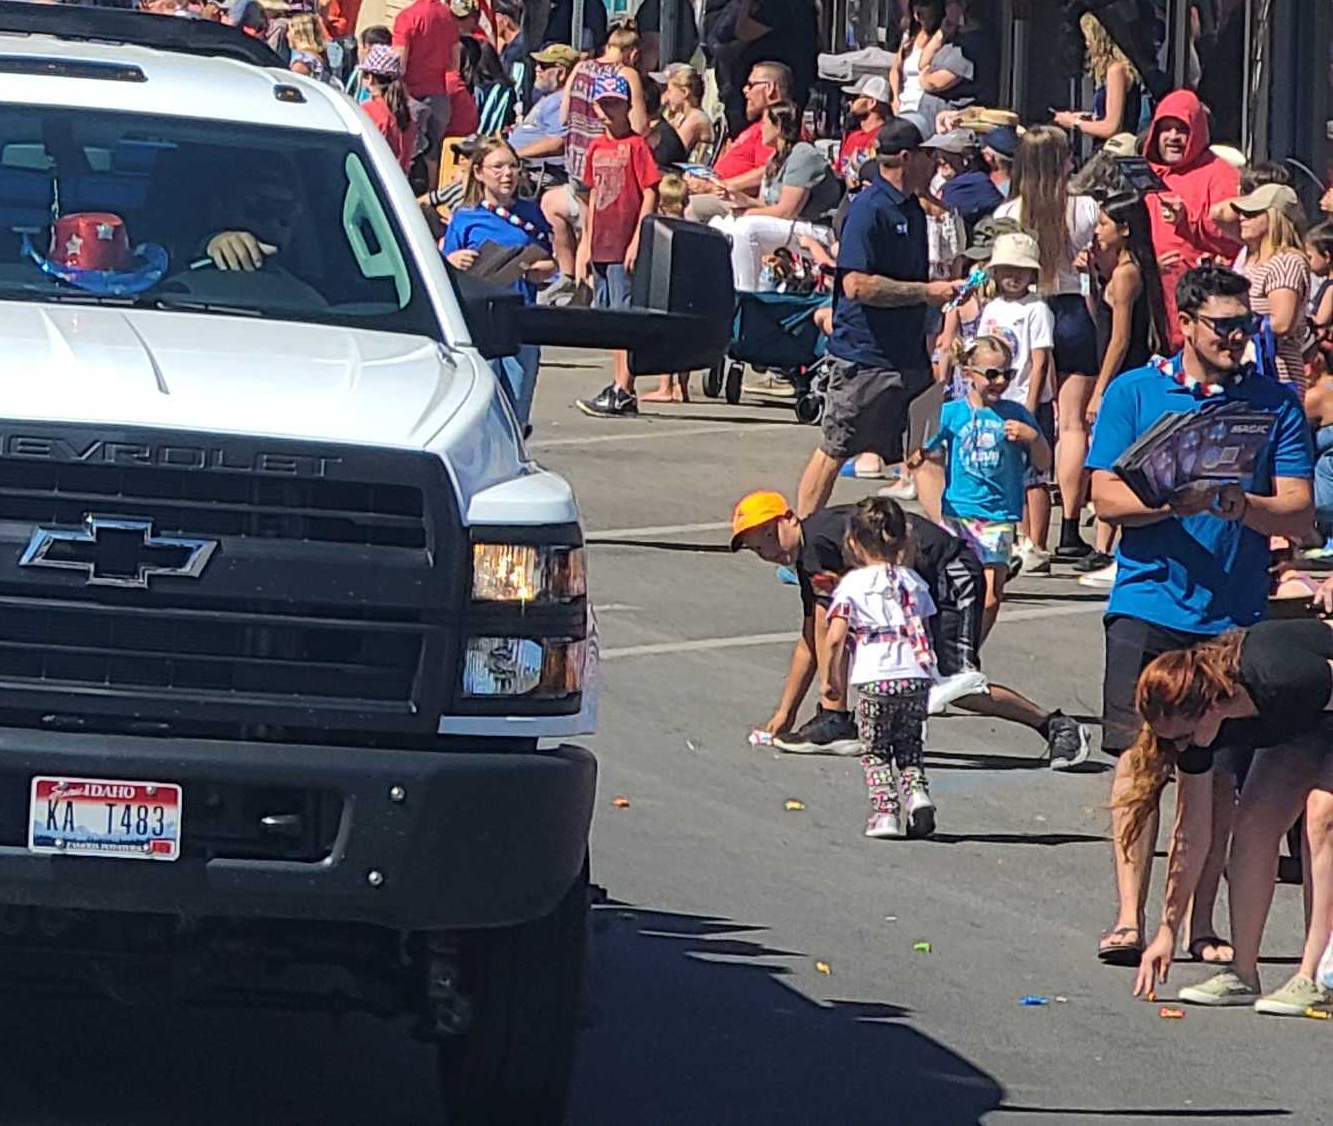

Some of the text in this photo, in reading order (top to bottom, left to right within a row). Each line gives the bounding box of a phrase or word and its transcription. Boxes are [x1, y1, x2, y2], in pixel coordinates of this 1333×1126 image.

[84, 783, 136, 799] IDAHO
[46, 798, 165, 837] KA T483
